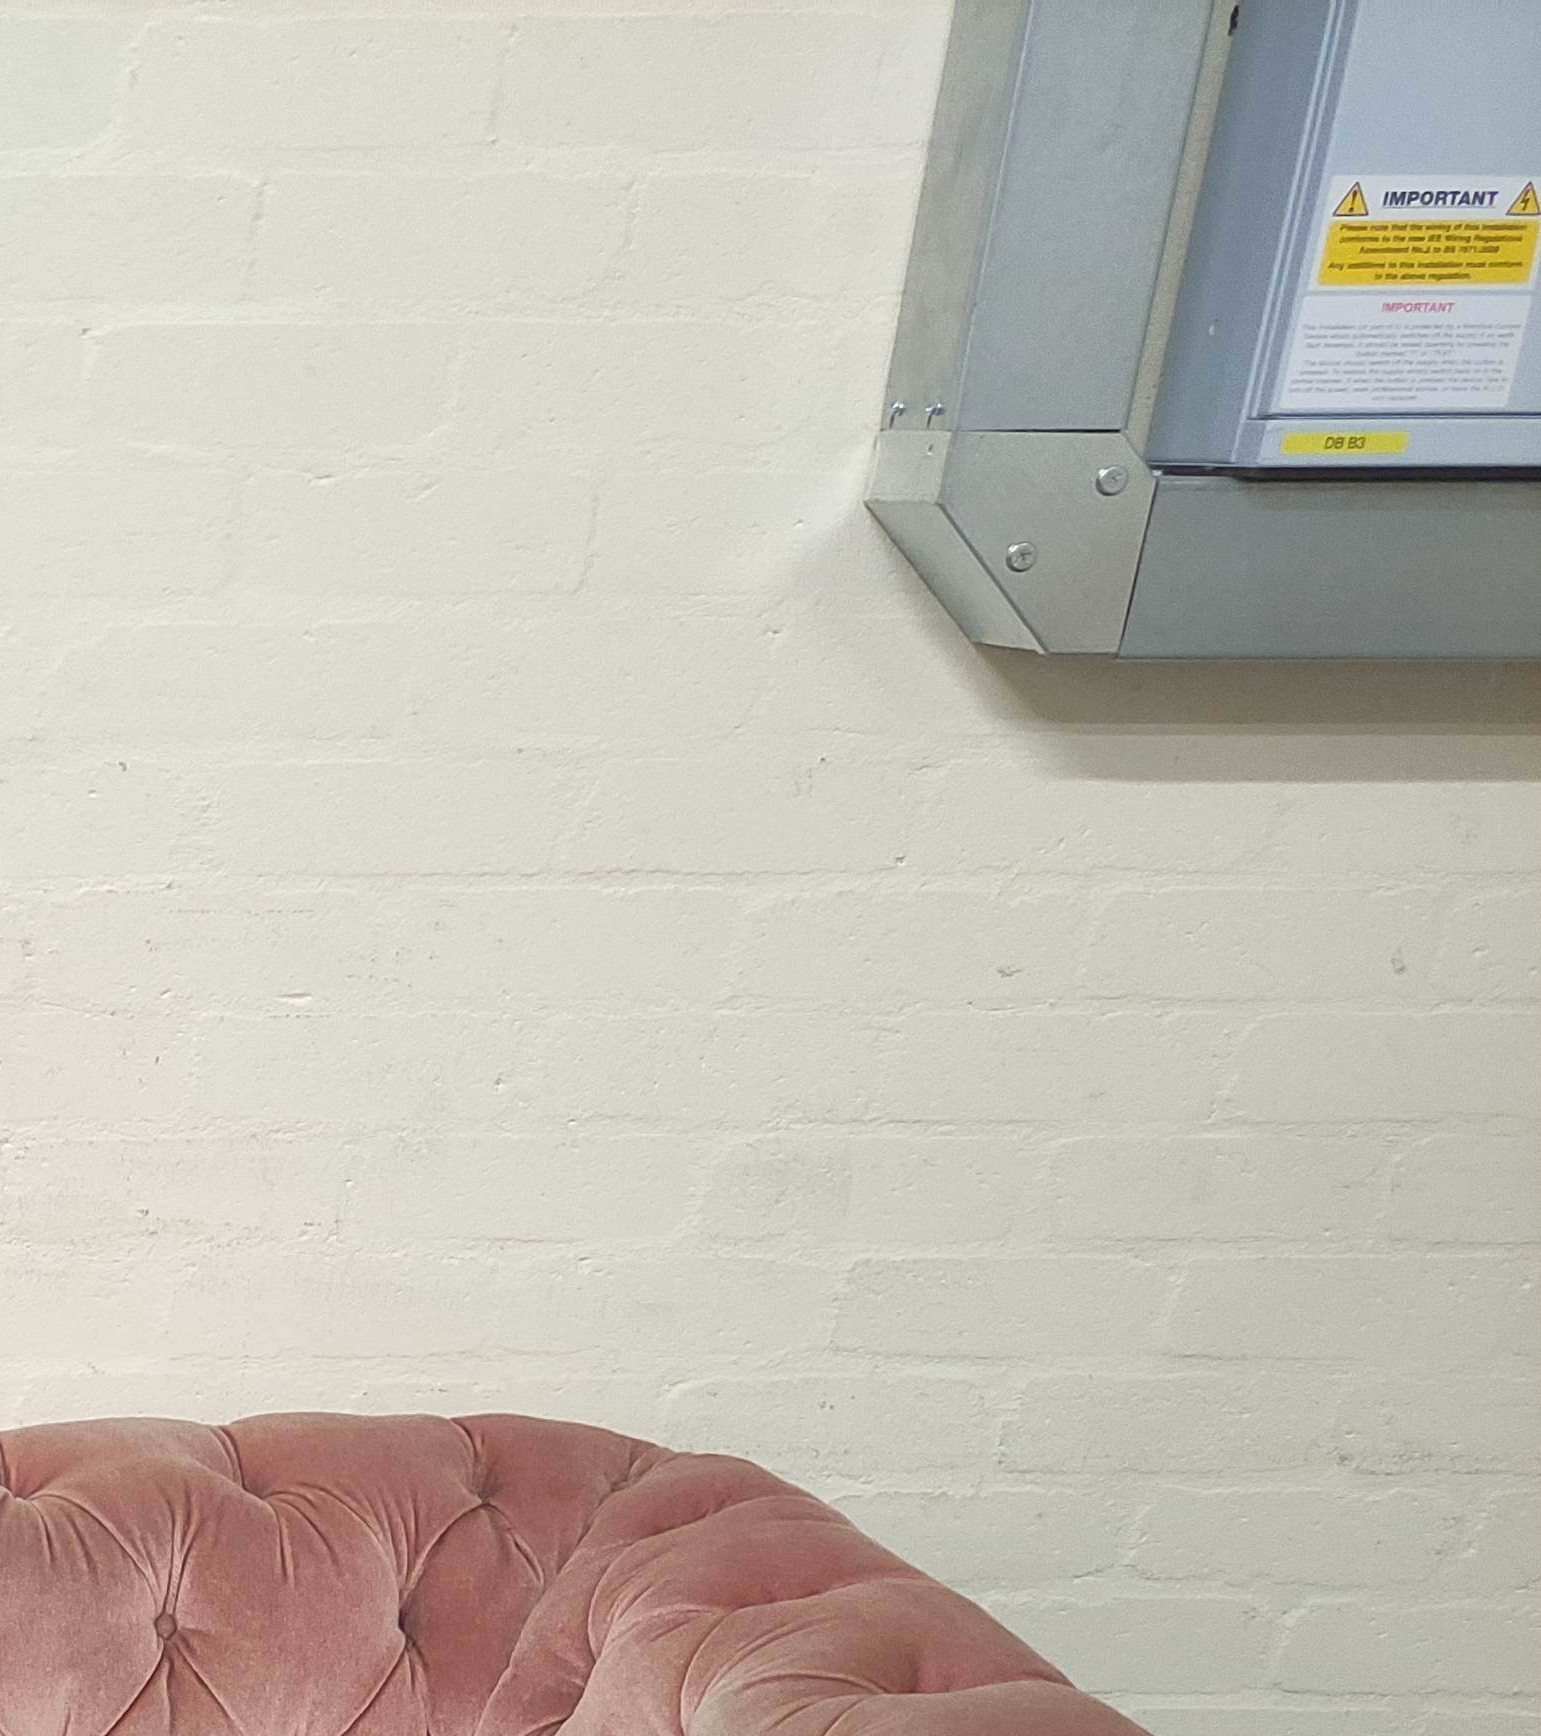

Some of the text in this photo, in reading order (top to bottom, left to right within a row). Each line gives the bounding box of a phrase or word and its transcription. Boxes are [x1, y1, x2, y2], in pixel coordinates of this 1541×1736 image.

[1382, 191, 1499, 206] IMPORTANT
[1381, 302, 1455, 313] IMPORTANT
[1324, 436, 1366, 449] DB B3
